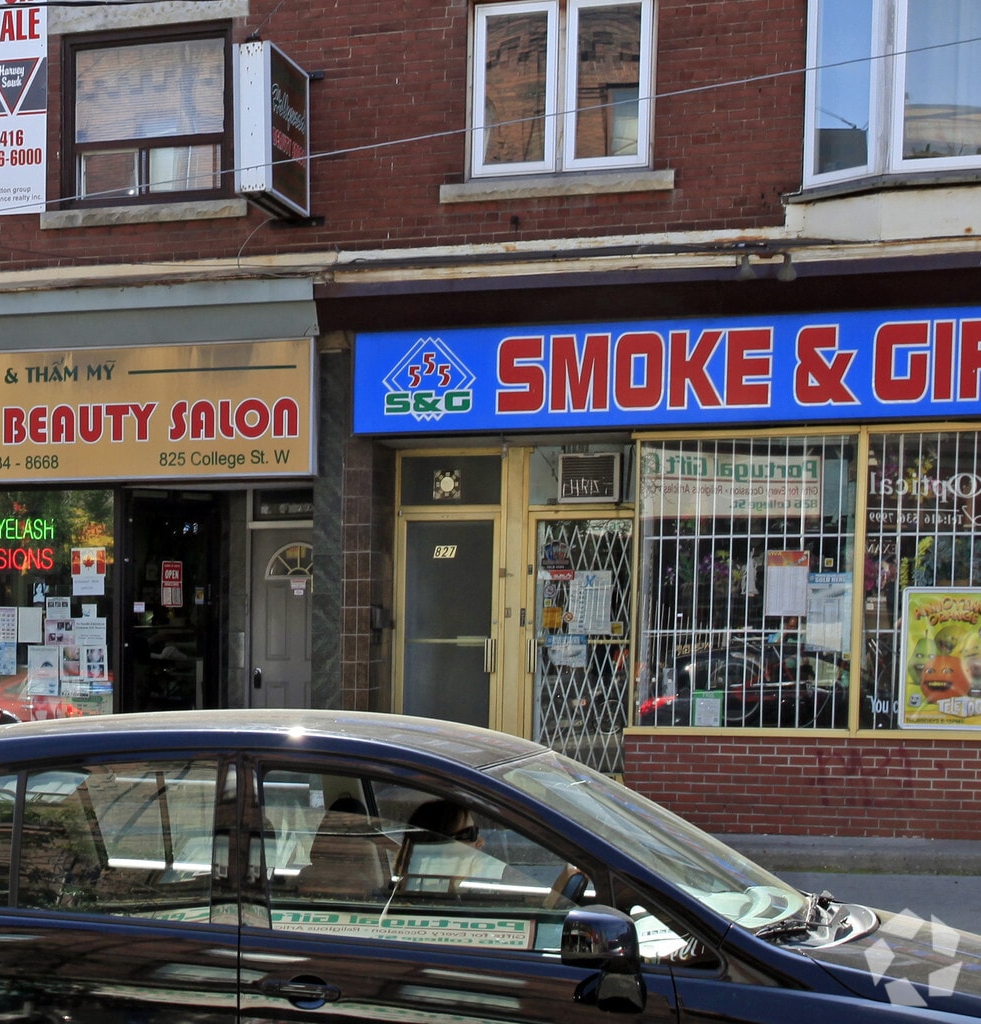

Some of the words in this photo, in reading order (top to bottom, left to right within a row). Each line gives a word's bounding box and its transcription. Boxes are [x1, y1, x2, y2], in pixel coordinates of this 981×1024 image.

[0, 129, 24, 147] 416
[12, 186, 31, 195] group
[4, 368, 19, 384] &
[495, 327, 773, 415] SMOKE
[793, 323, 861, 406] &
[384, 389, 473, 415] S&G
[2, 401, 159, 446] BEAUTY
[168, 395, 300, 443] SALON
[25, 455, 59, 470] 8668
[159, 452, 186, 467] 825
[190, 450, 246, 469] College
[250, 450, 269, 465] St.
[274, 449, 291, 464] W
[434, 546, 457, 559] 827
[164, 569, 179, 580] OPEN
